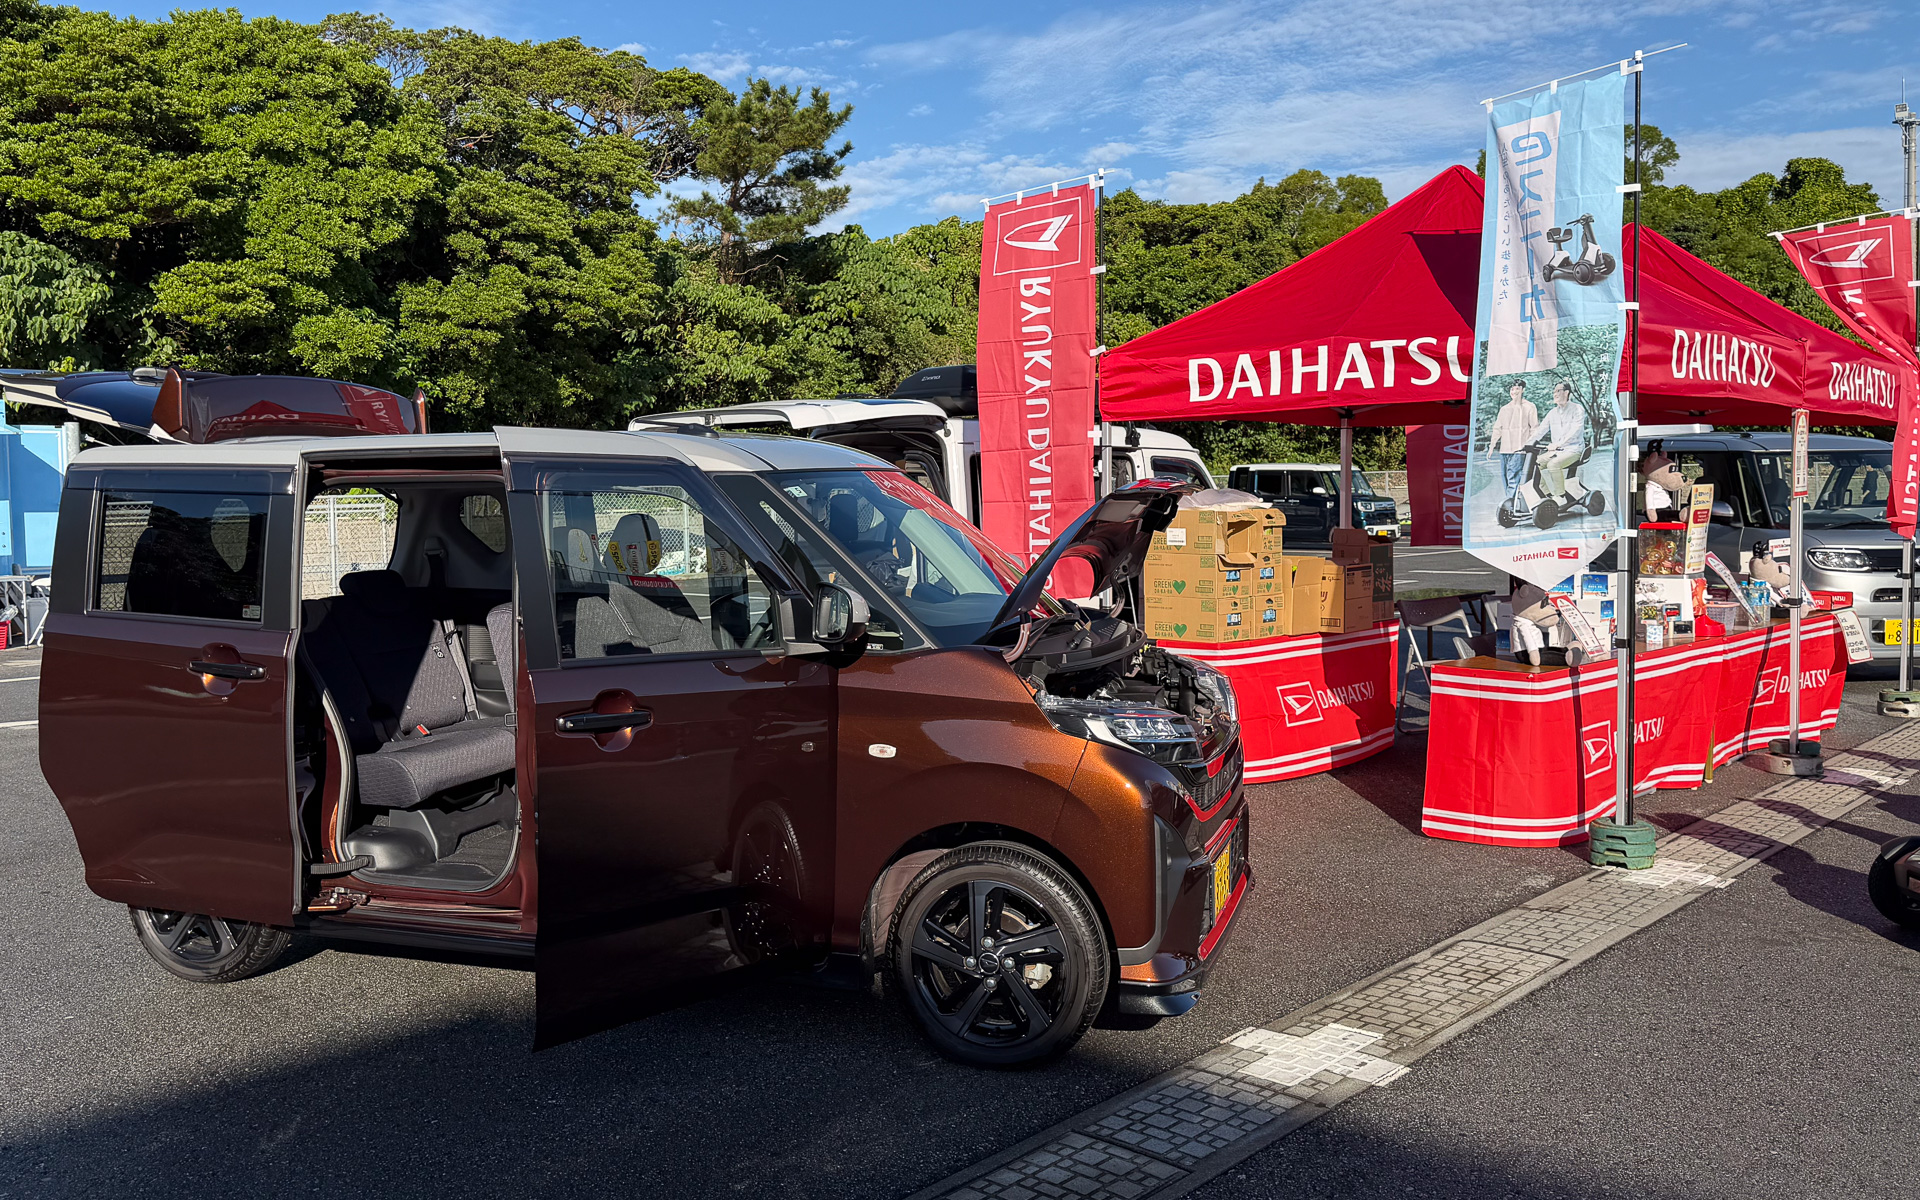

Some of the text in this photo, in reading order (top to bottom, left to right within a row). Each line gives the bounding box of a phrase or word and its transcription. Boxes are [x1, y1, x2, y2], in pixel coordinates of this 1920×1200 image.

[1188, 335, 1472, 402] DAIHATSU
[1671, 329, 1776, 388] DAIHATSU
[1828, 361, 1896, 409] DAIHATSU
[1153, 537, 1167, 545] GREE
[1153, 580, 1172, 589] GREEN
[1154, 622, 1173, 631] GREEN
[1316, 681, 1375, 709] DAIHATSU
